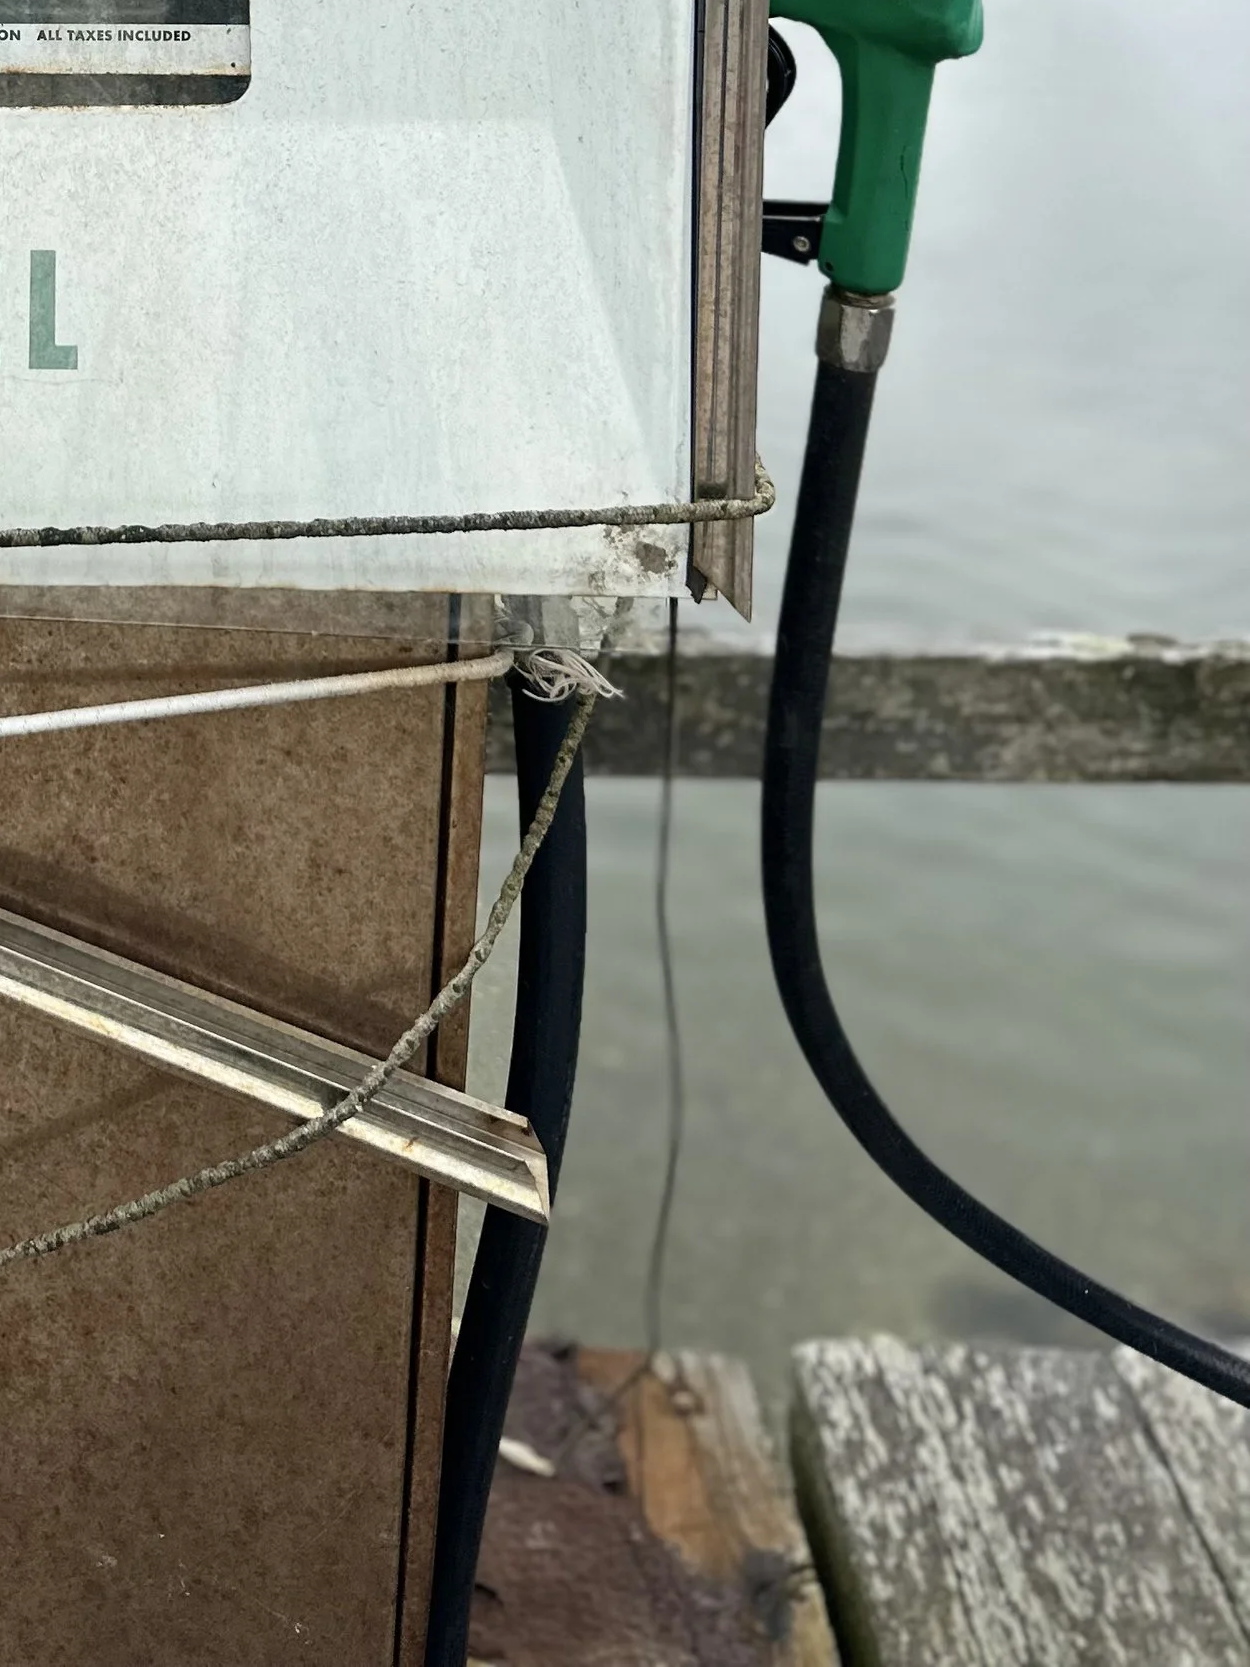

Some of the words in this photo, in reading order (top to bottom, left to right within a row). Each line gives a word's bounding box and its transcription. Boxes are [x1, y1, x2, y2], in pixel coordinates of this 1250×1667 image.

[36, 28, 62, 42] ALL
[67, 28, 113, 42] TAXES
[117, 29, 192, 42] INCLUDED
